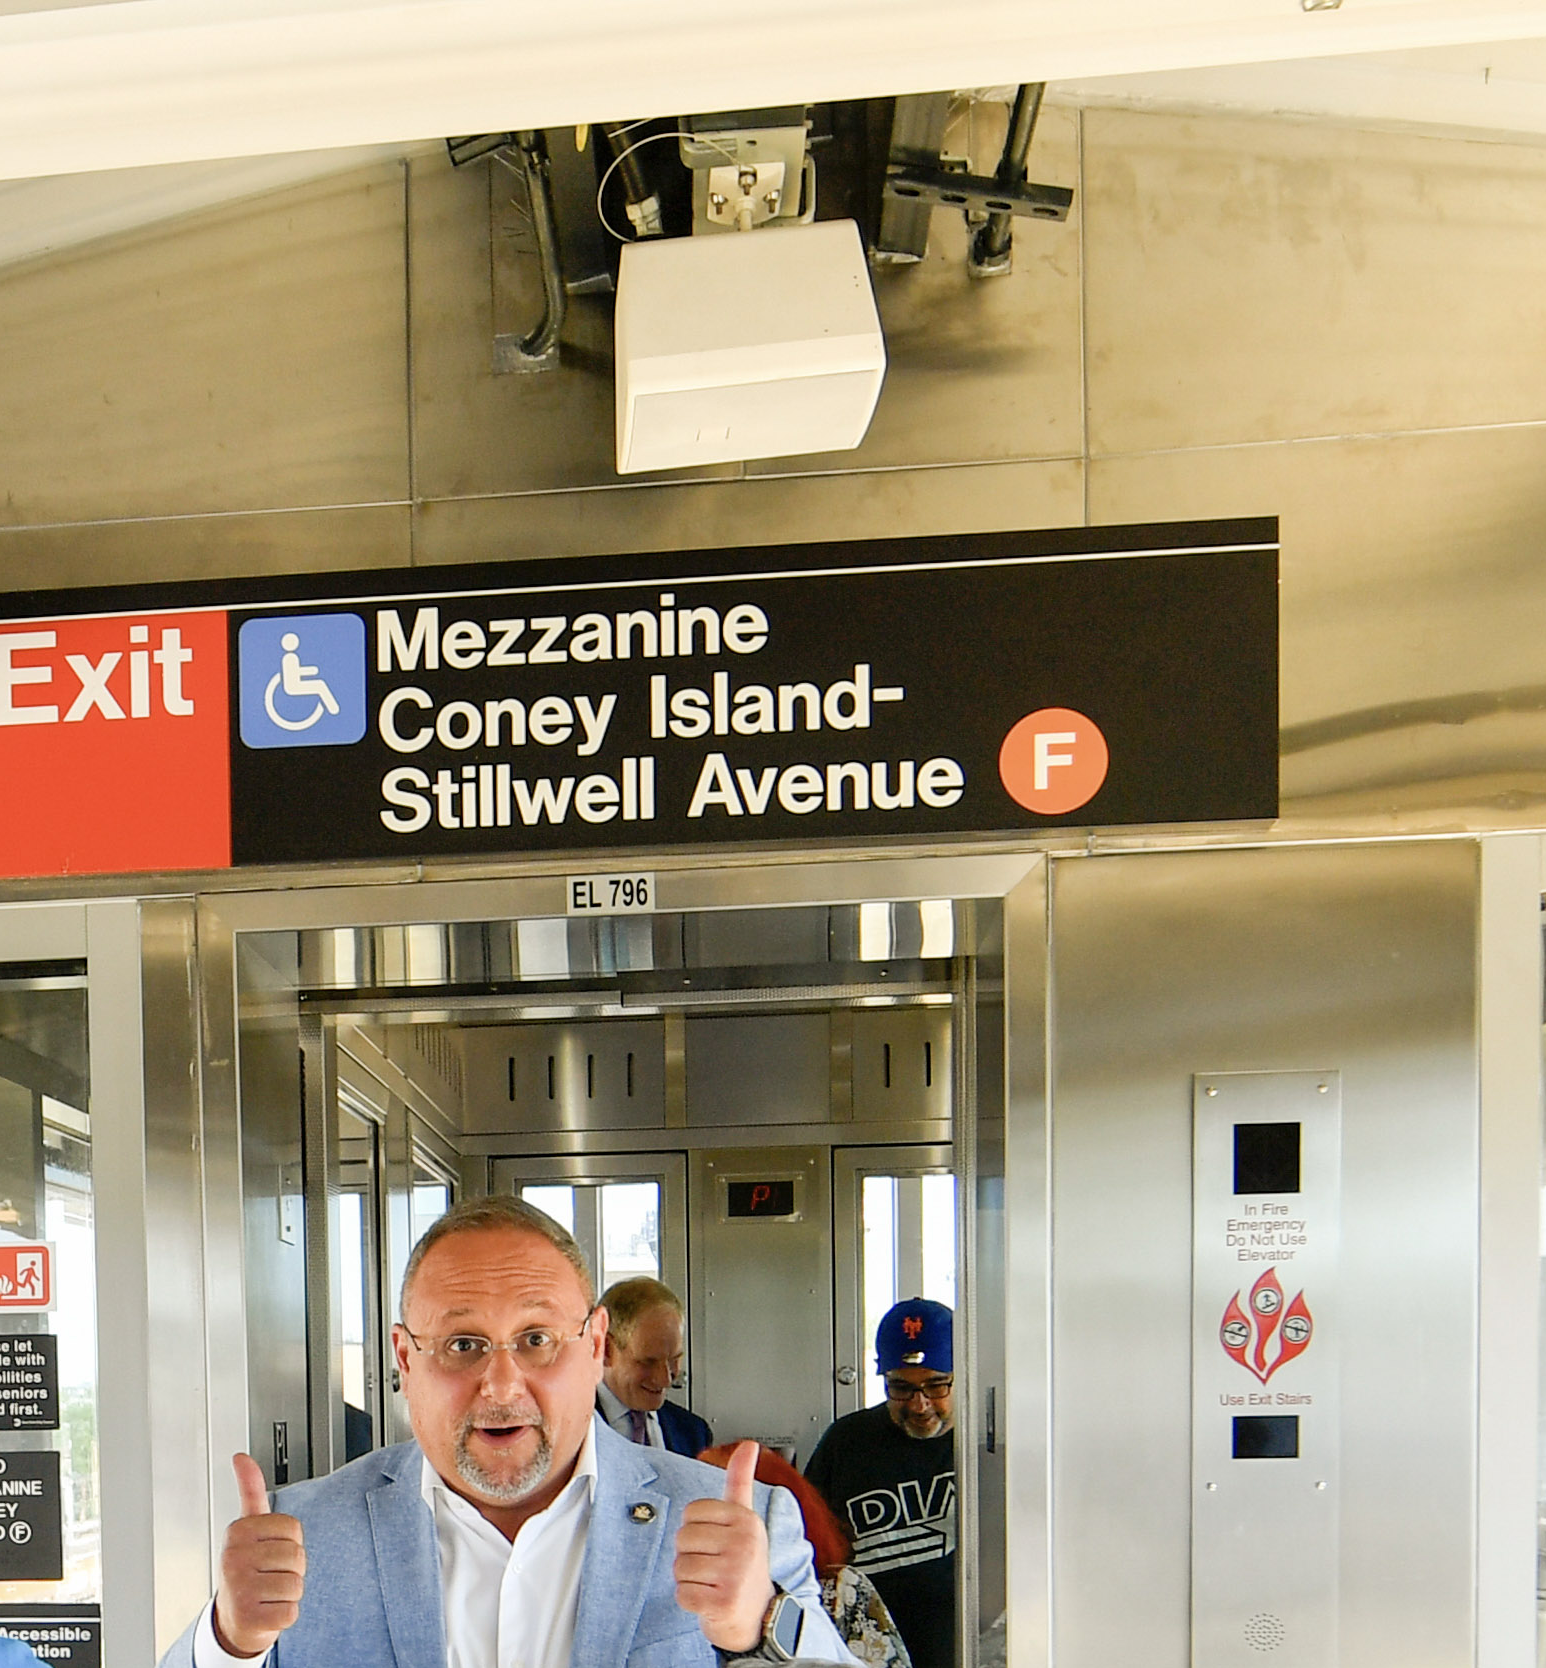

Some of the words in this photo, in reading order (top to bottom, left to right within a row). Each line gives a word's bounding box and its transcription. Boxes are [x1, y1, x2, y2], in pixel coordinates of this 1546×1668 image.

[378, 590, 769, 672] Mezzanine
[379, 687, 617, 756] Coney
[650, 664, 904, 738] Island-
[1033, 731, 1077, 791] F
[381, 756, 655, 833] Stillwell
[688, 753, 964, 818] Avenue
[573, 881, 602, 909] EL
[609, 878, 648, 907] 796
[1245, 1204, 1257, 1216] In
[1261, 1203, 1289, 1216] Fire
[1226, 1219, 1306, 1233] Emergency
[1226, 1234, 1246, 1247] Do
[1250, 1234, 1275, 1246] Not
[1279, 1233, 1307, 1246] Use
[1237, 1249, 1296, 1261] Elevator
[14, 1339, 33, 1352] let
[15, 1353, 46, 1366] with
[1219, 1394, 1245, 1406] Use
[1276, 1393, 1312, 1405] Stairs
[9, 1402, 43, 1416] first.
